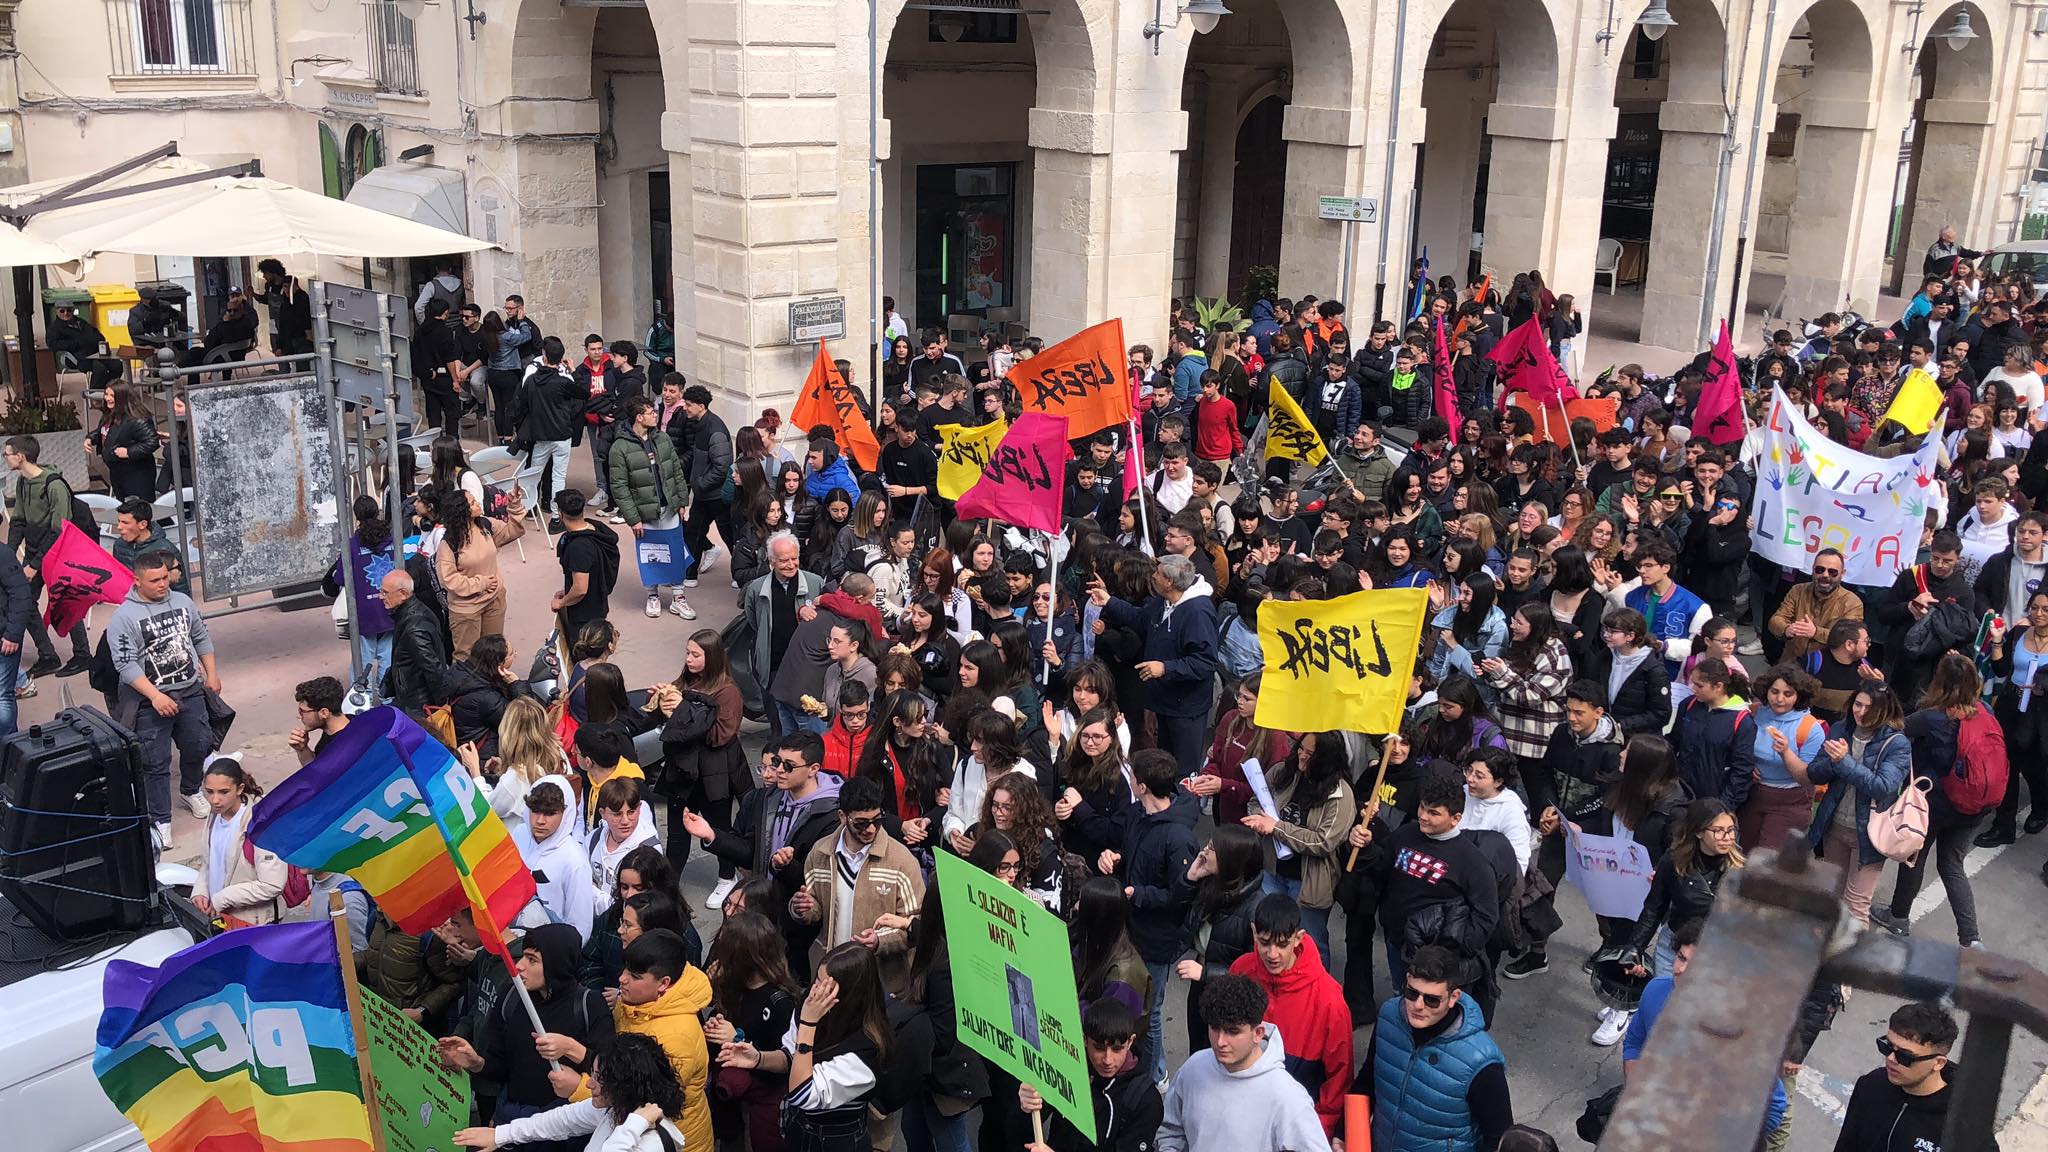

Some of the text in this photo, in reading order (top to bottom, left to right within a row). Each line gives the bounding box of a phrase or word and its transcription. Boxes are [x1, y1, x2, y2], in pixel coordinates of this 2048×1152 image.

[1664, 611, 1686, 637] S
[967, 883, 976, 905] IL
[978, 890, 1017, 929] SILENZIO
[988, 921, 1018, 955] MAFIA
[1039, 1019, 1061, 1046] SENZA
[961, 1007, 1078, 1109] SALVATORE INCARDONA
